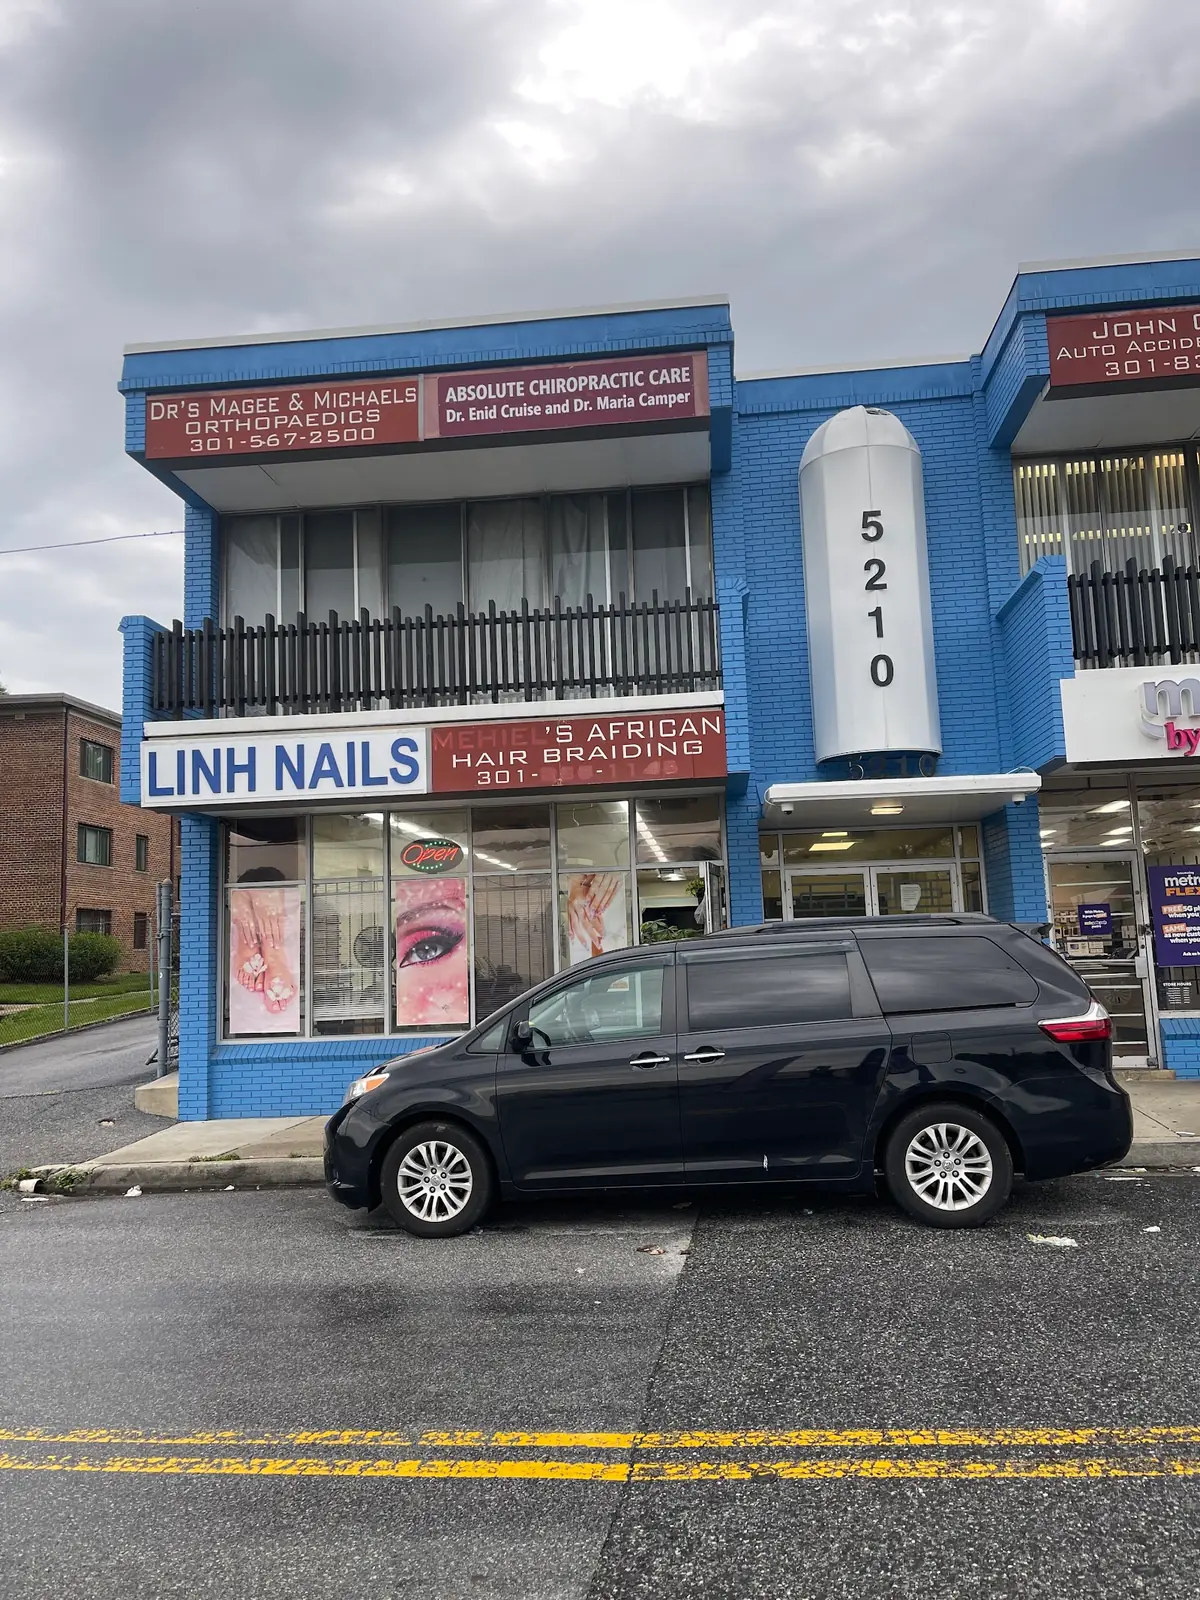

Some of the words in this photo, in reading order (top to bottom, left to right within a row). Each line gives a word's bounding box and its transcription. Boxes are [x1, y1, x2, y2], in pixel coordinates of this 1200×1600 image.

[1092, 318, 1177, 339] JOHN
[1056, 344, 1116, 360] AUTO
[445, 381, 525, 403] ABSOLUTE
[529, 370, 645, 396] CHIROPRACTIC
[649, 366, 691, 386] CARE
[210, 397, 280, 417] MAGEE
[288, 393, 304, 411] &
[314, 387, 417, 410] MICHAELS
[446, 408, 465, 423] Dr.
[469, 405, 497, 421] Enid
[500, 402, 541, 418] Cruise
[545, 399, 570, 416] and
[573, 397, 593, 412] Dr.
[596, 394, 635, 410] Maria
[638, 390, 691, 409] Camper
[185, 409, 381, 435] ORTHOPAEDICS
[190, 427, 375, 452] 301-567-2500
[587, 716, 721, 743] AFRICAN
[148, 746, 256, 797] LINH
[275, 737, 420, 790] NAILS
[452, 750, 528, 769] HAIR
[543, 740, 703, 764] BRAIDING
[403, 844, 459, 865] Open
[1164, 874, 1200, 887] metr
